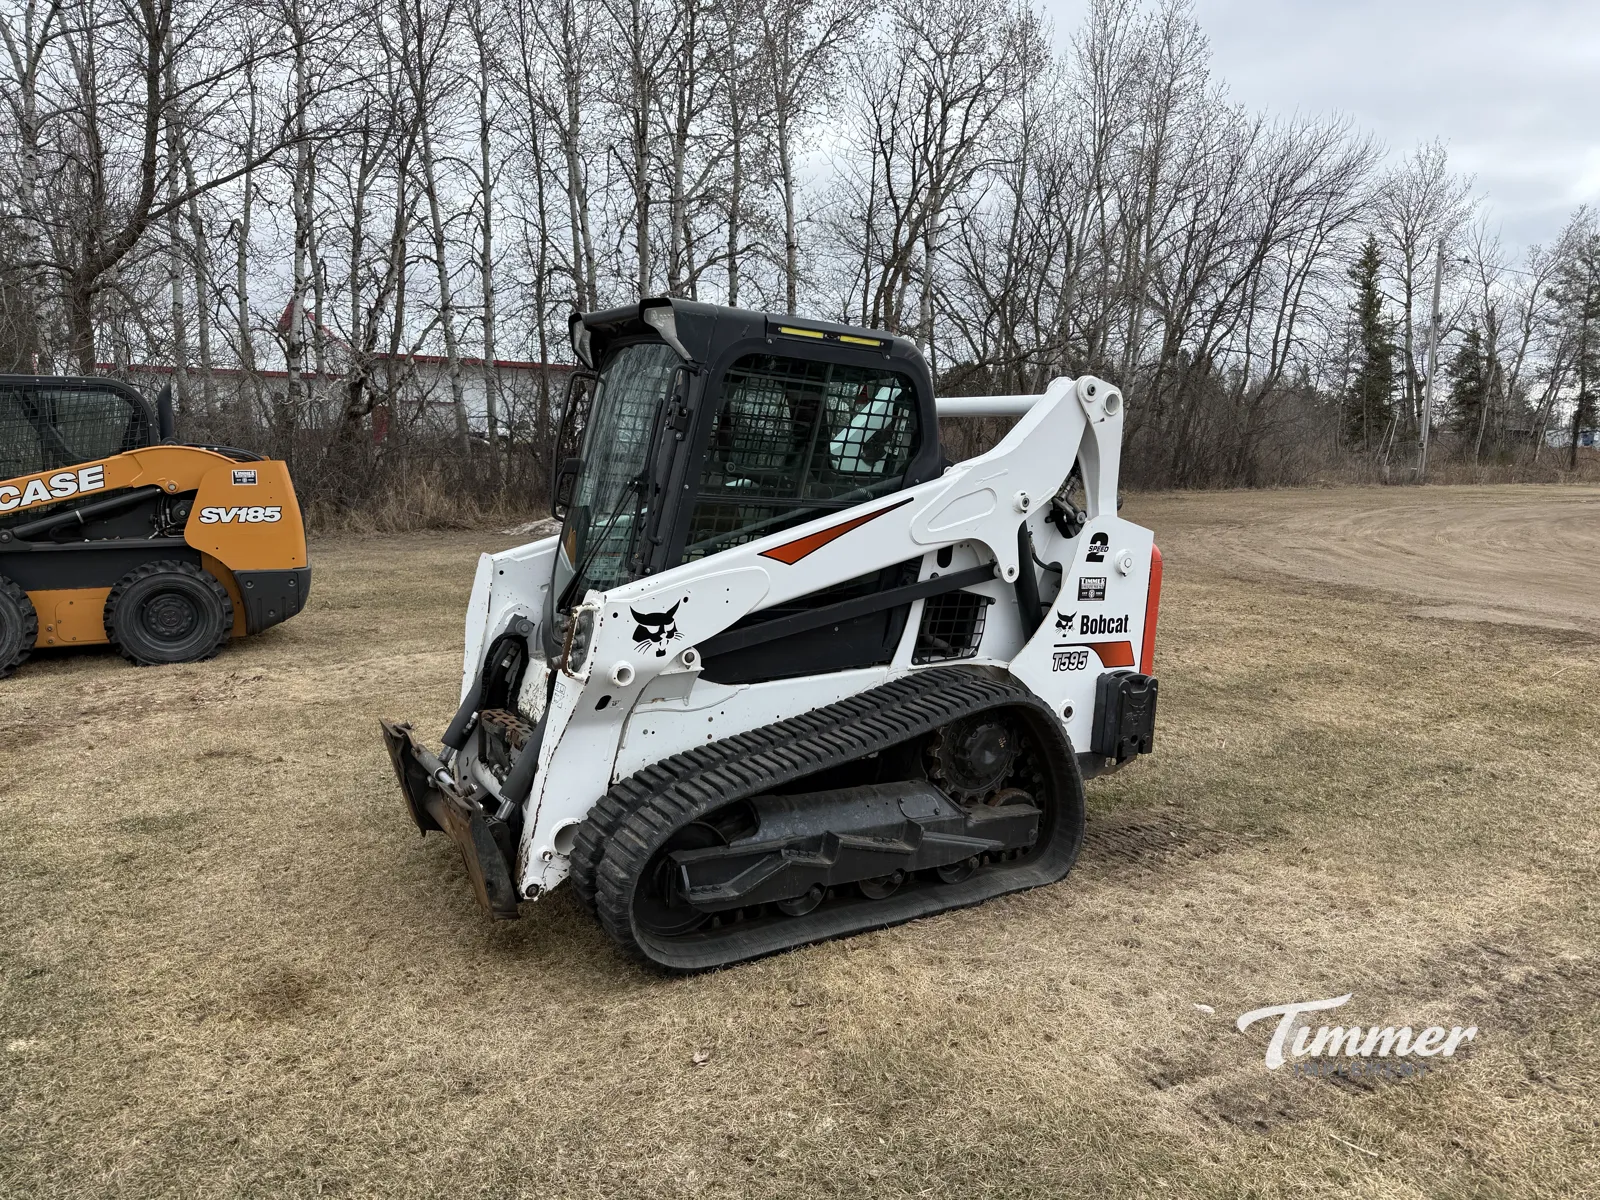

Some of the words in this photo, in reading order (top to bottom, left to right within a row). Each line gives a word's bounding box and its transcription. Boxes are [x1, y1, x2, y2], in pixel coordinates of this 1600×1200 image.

[0, 465, 104, 511] CASE
[199, 506, 282, 523] SV185
[1086, 532, 1108, 562] 2
[1080, 614, 1128, 635] Bobcat
[1053, 651, 1088, 672] T595
